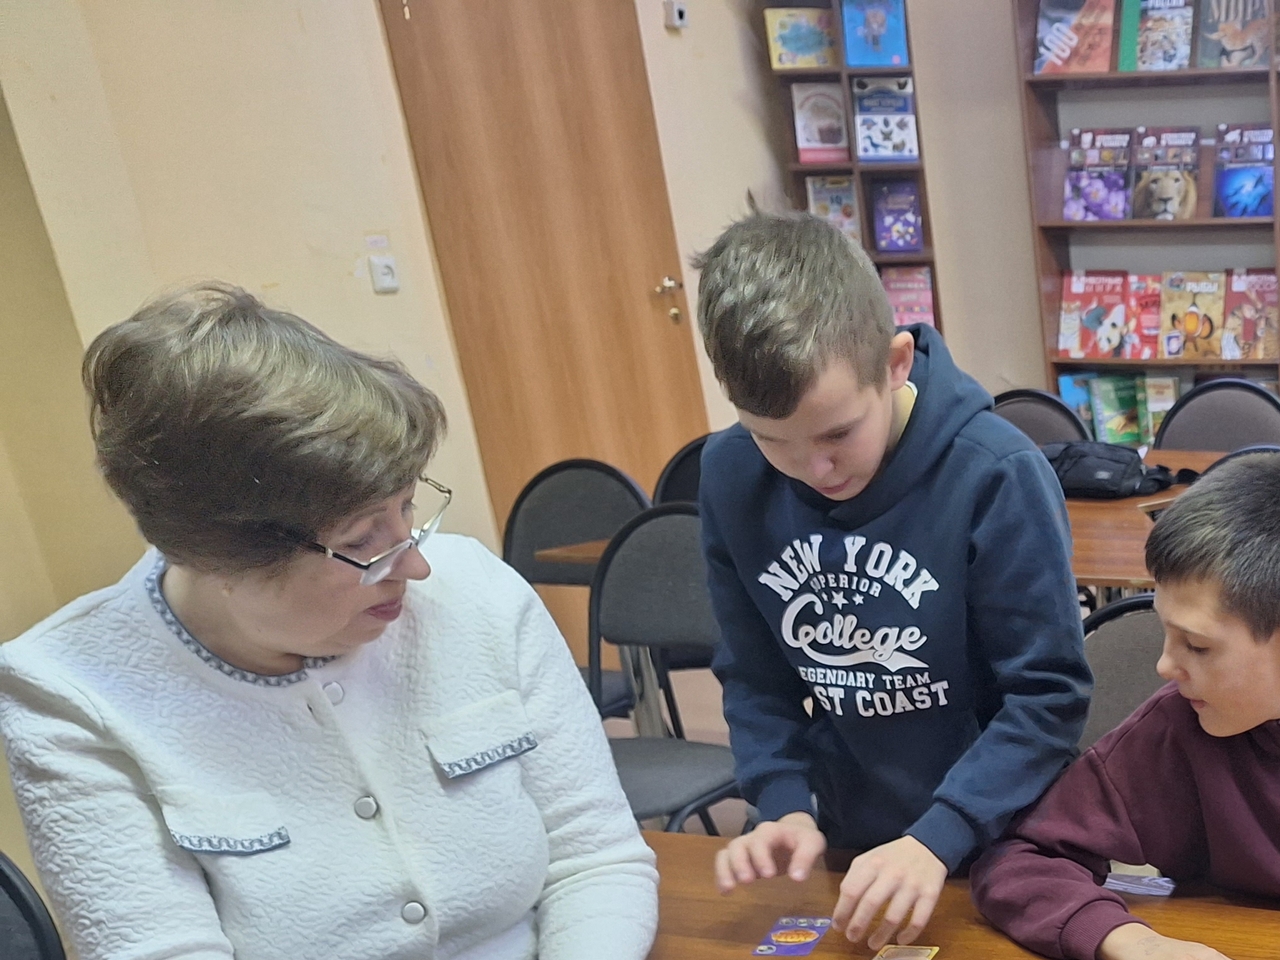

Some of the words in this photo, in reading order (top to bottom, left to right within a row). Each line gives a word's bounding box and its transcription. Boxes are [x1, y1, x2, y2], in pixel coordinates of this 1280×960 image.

[758, 533, 824, 603] NEW
[842, 534, 941, 611] YORK
[809, 573, 883, 599] SUPERIOR
[781, 592, 929, 662] College
[798, 666, 877, 691] EGENDARY
[882, 671, 932, 691] TEAM
[814, 686, 846, 717] ST
[855, 680, 950, 719] COAST
